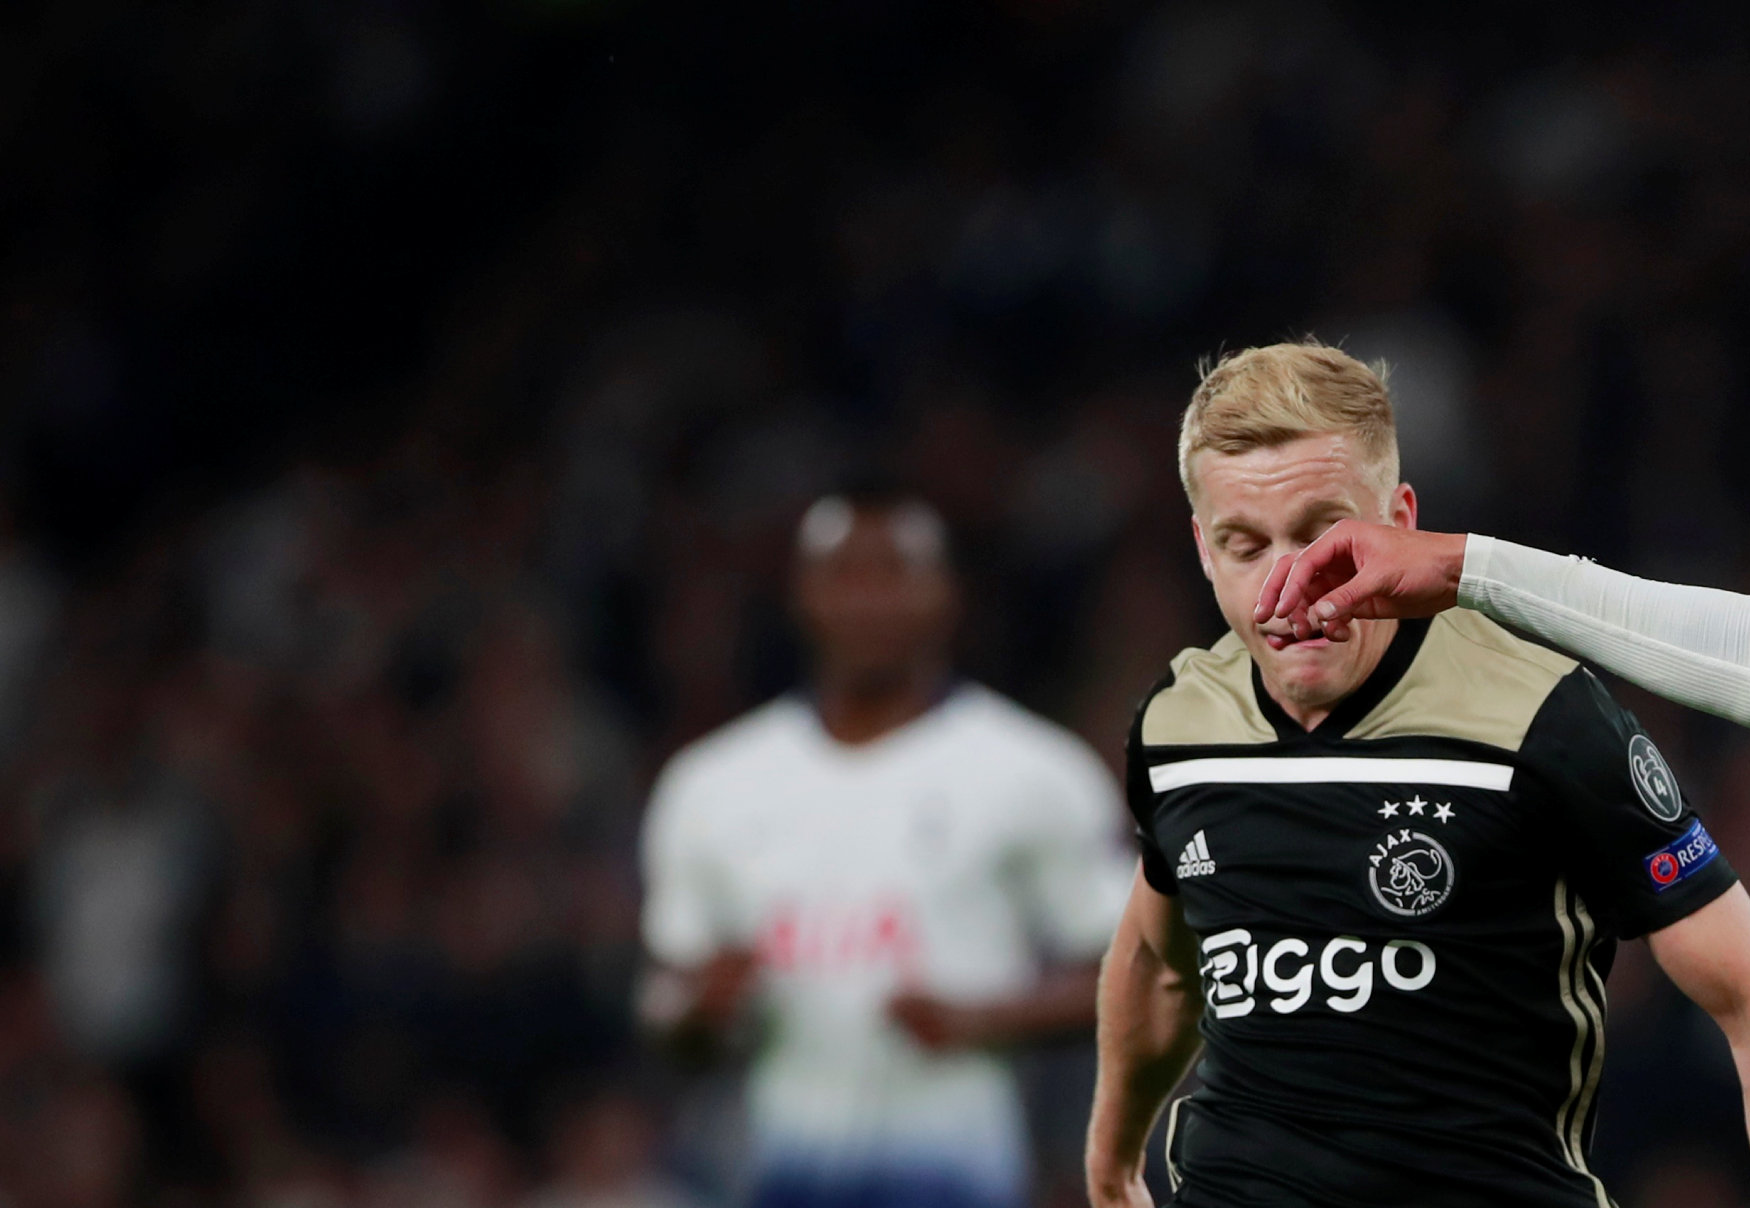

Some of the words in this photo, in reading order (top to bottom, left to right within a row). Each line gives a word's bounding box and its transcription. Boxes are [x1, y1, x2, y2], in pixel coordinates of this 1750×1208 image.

[1652, 775, 1668, 796] 4
[1368, 828, 1412, 868] AJAX
[1176, 859, 1216, 880] adidas
